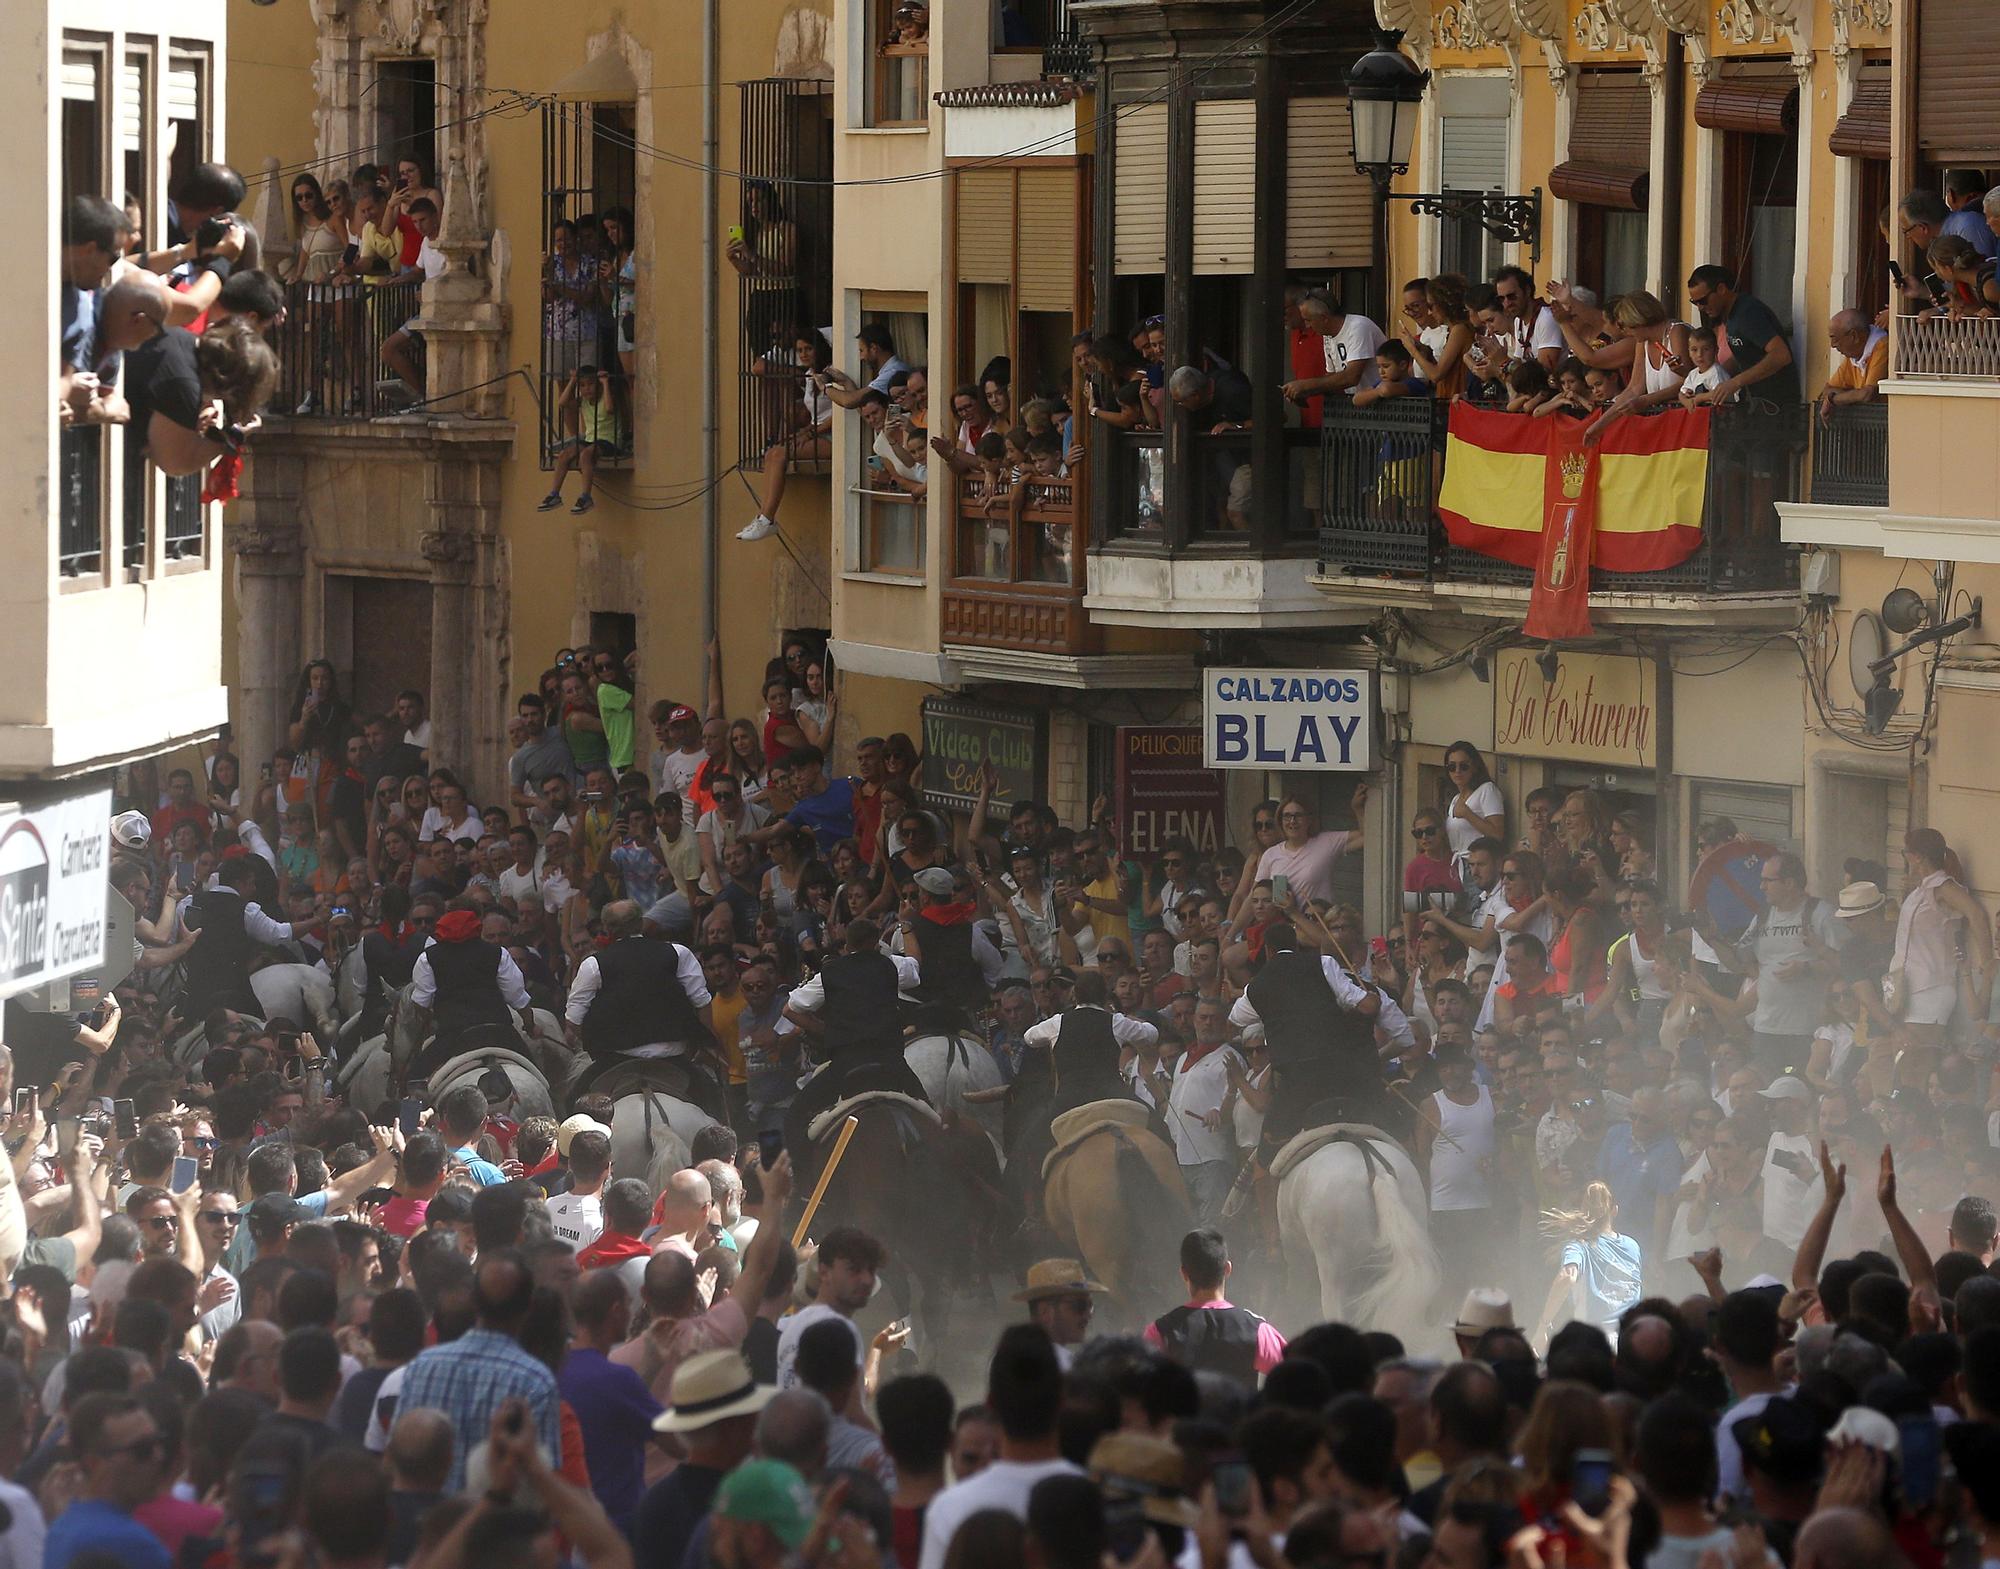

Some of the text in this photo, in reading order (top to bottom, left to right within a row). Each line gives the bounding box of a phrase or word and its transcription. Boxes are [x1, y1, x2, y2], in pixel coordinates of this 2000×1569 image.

[1216, 677, 1360, 703] CALZADOS
[1497, 657, 1650, 751] La Costurera
[927, 718, 1033, 770] Video Club
[1215, 713, 1361, 764] BLAY
[1130, 809, 1218, 852] ELENA
[0, 882, 46, 973] Santa
[559, 1226, 580, 1242] DREAM
